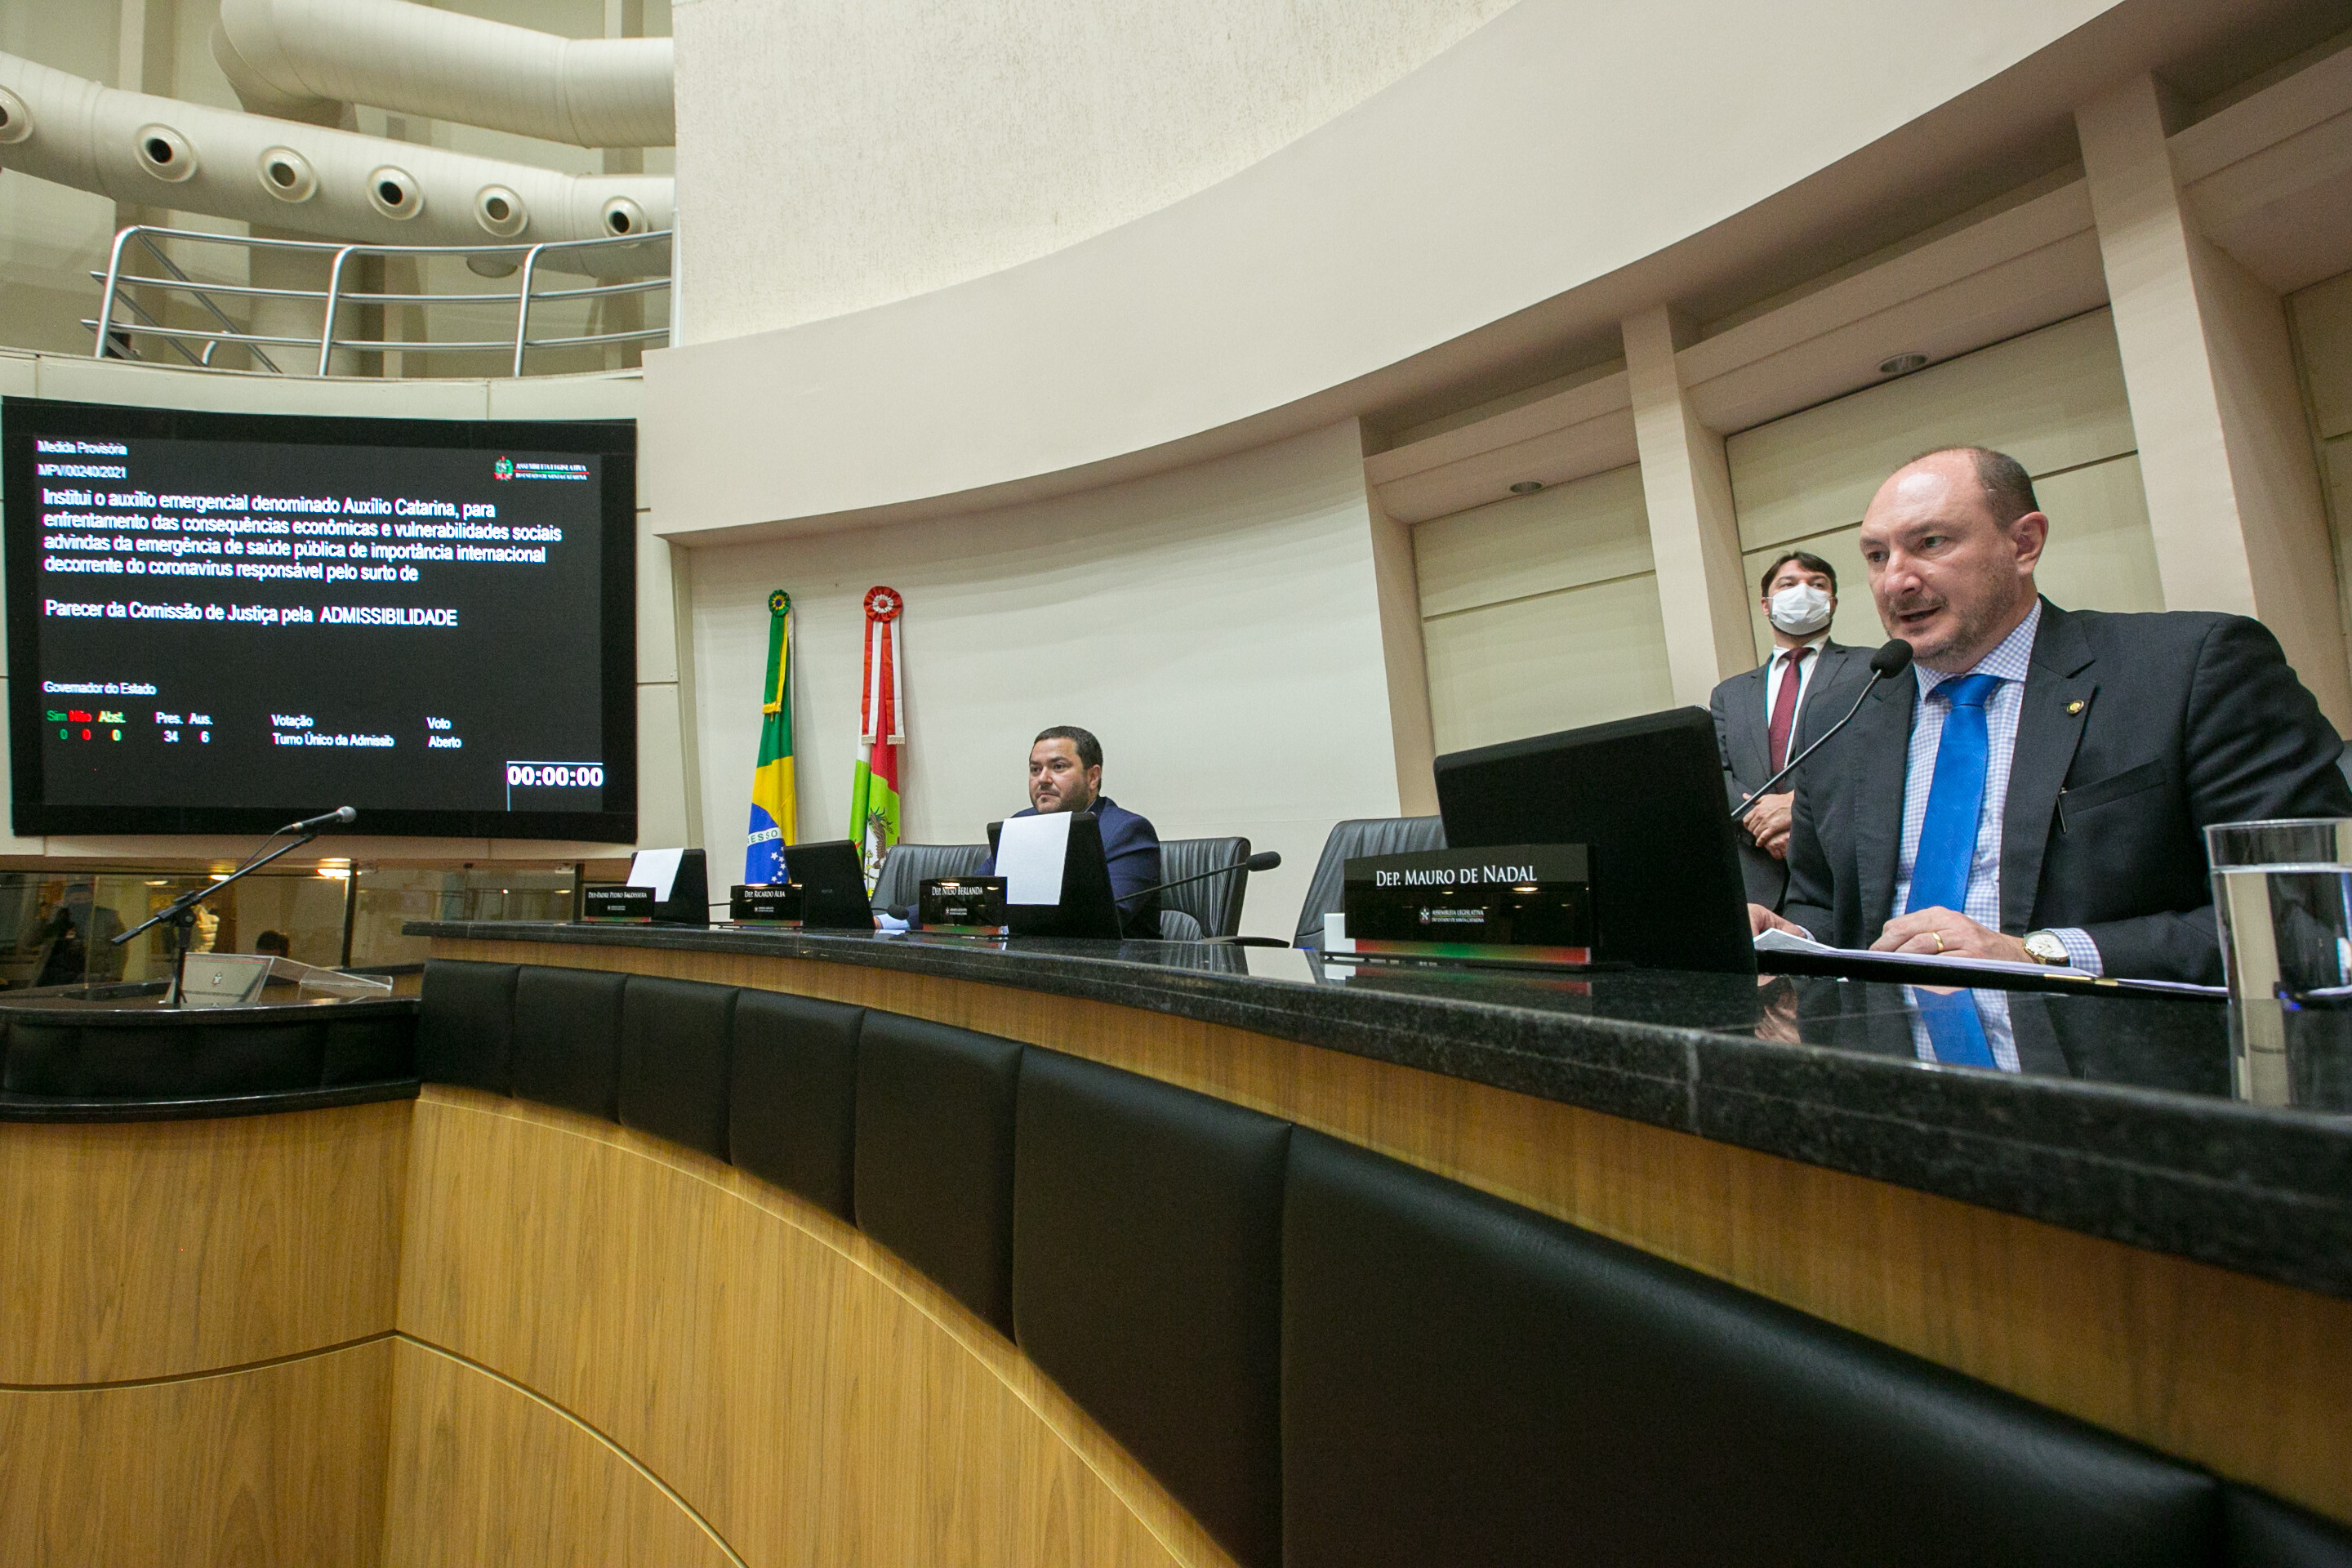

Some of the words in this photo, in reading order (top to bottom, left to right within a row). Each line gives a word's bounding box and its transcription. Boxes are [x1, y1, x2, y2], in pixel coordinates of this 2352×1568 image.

[37, 440, 76, 454] Medida
[77, 442, 127, 456] Provisória
[42, 488, 92, 506] Institui
[94, 492, 105, 506] o
[107, 490, 156, 508] auxílio
[158, 494, 248, 513] emergencial
[251, 495, 340, 514] denominado
[342, 497, 392, 515] Auxílio
[394, 498, 460, 519] Catarina,
[462, 502, 496, 519] para
[42, 511, 149, 530] enfrentamento
[151, 513, 180, 531] das
[181, 516, 289, 537] consequências
[292, 519, 378, 537] econômicas
[381, 524, 391, 537] e
[394, 521, 509, 540] vulnerabilidades
[512, 525, 563, 541] sociais
[43, 534, 110, 551] advindas
[113, 535, 133, 551] da
[135, 537, 221, 556] emergência
[224, 537, 243, 555] de
[246, 539, 292, 556] saúde
[293, 540, 345, 559] pública
[349, 542, 368, 558] de
[370, 542, 453, 562] importância
[457, 546, 546, 564] internacional
[43, 556, 123, 573] decorrente
[126, 558, 146, 574] do
[148, 559, 233, 577] coronavírus
[236, 562, 323, 581] responsável
[326, 564, 358, 583] pelo
[360, 566, 397, 581] surto
[399, 565, 419, 581] de
[45, 599, 105, 617] Parecer
[106, 601, 127, 618] da
[128, 602, 203, 620] Comissão
[205, 604, 225, 621] de
[227, 604, 278, 625] Justiça
[280, 606, 314, 626] pela
[319, 606, 458, 626] ADMISSIBILIDADE
[42, 681, 104, 694] Governador
[105, 683, 119, 694] do
[120, 682, 157, 695] Estado
[47, 710, 67, 722] Sim
[69, 710, 91, 723] Não
[154, 711, 183, 725] Pres.
[188, 712, 213, 725] Aus.
[270, 714, 314, 728] Votação
[426, 716, 452, 730] Voto
[60, 728, 68, 741] 0
[82, 728, 91, 741] 0
[111, 728, 122, 742] 0
[163, 730, 179, 742] 34
[200, 730, 210, 743] 6
[273, 732, 303, 746] Turno
[305, 730, 333, 746] Único
[335, 733, 349, 746] da
[349, 733, 394, 747] Admissib
[427, 735, 462, 748] Aberto
[507, 765, 604, 786] 00:00:00
[1376, 870, 1401, 887] DEP.
[1405, 869, 1455, 885] MAURO
[1460, 868, 1478, 884] DE
[1484, 864, 1538, 883] NADAL
[957, 886, 983, 896] BERLANDA
